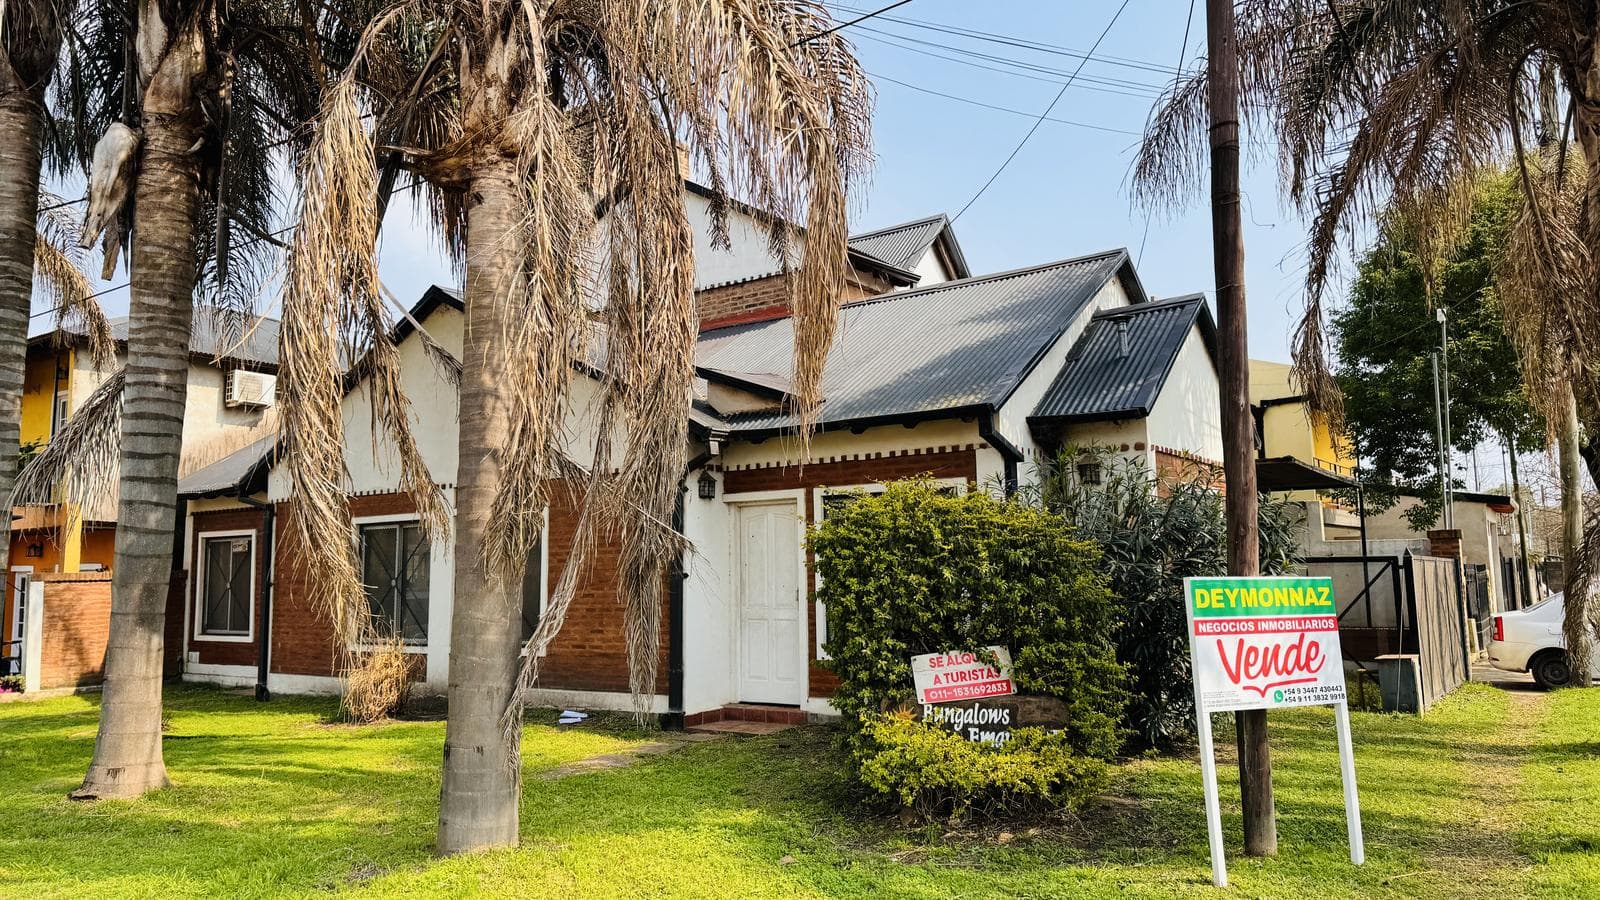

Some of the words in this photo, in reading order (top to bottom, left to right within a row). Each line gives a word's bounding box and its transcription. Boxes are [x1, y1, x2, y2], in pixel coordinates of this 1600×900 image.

[1194, 587, 1332, 609] DEYMONNAZ
[1198, 621, 1255, 633] NEGOCIOS
[1258, 619, 1335, 632] INMOBILIARIOS
[928, 656, 944, 669] SE
[1216, 632, 1326, 685] Vende
[933, 674, 943, 686] A
[943, 667, 1001, 684] TURISTAS
[1302, 686, 1318, 694] 3447
[1319, 685, 1343, 693] 430443
